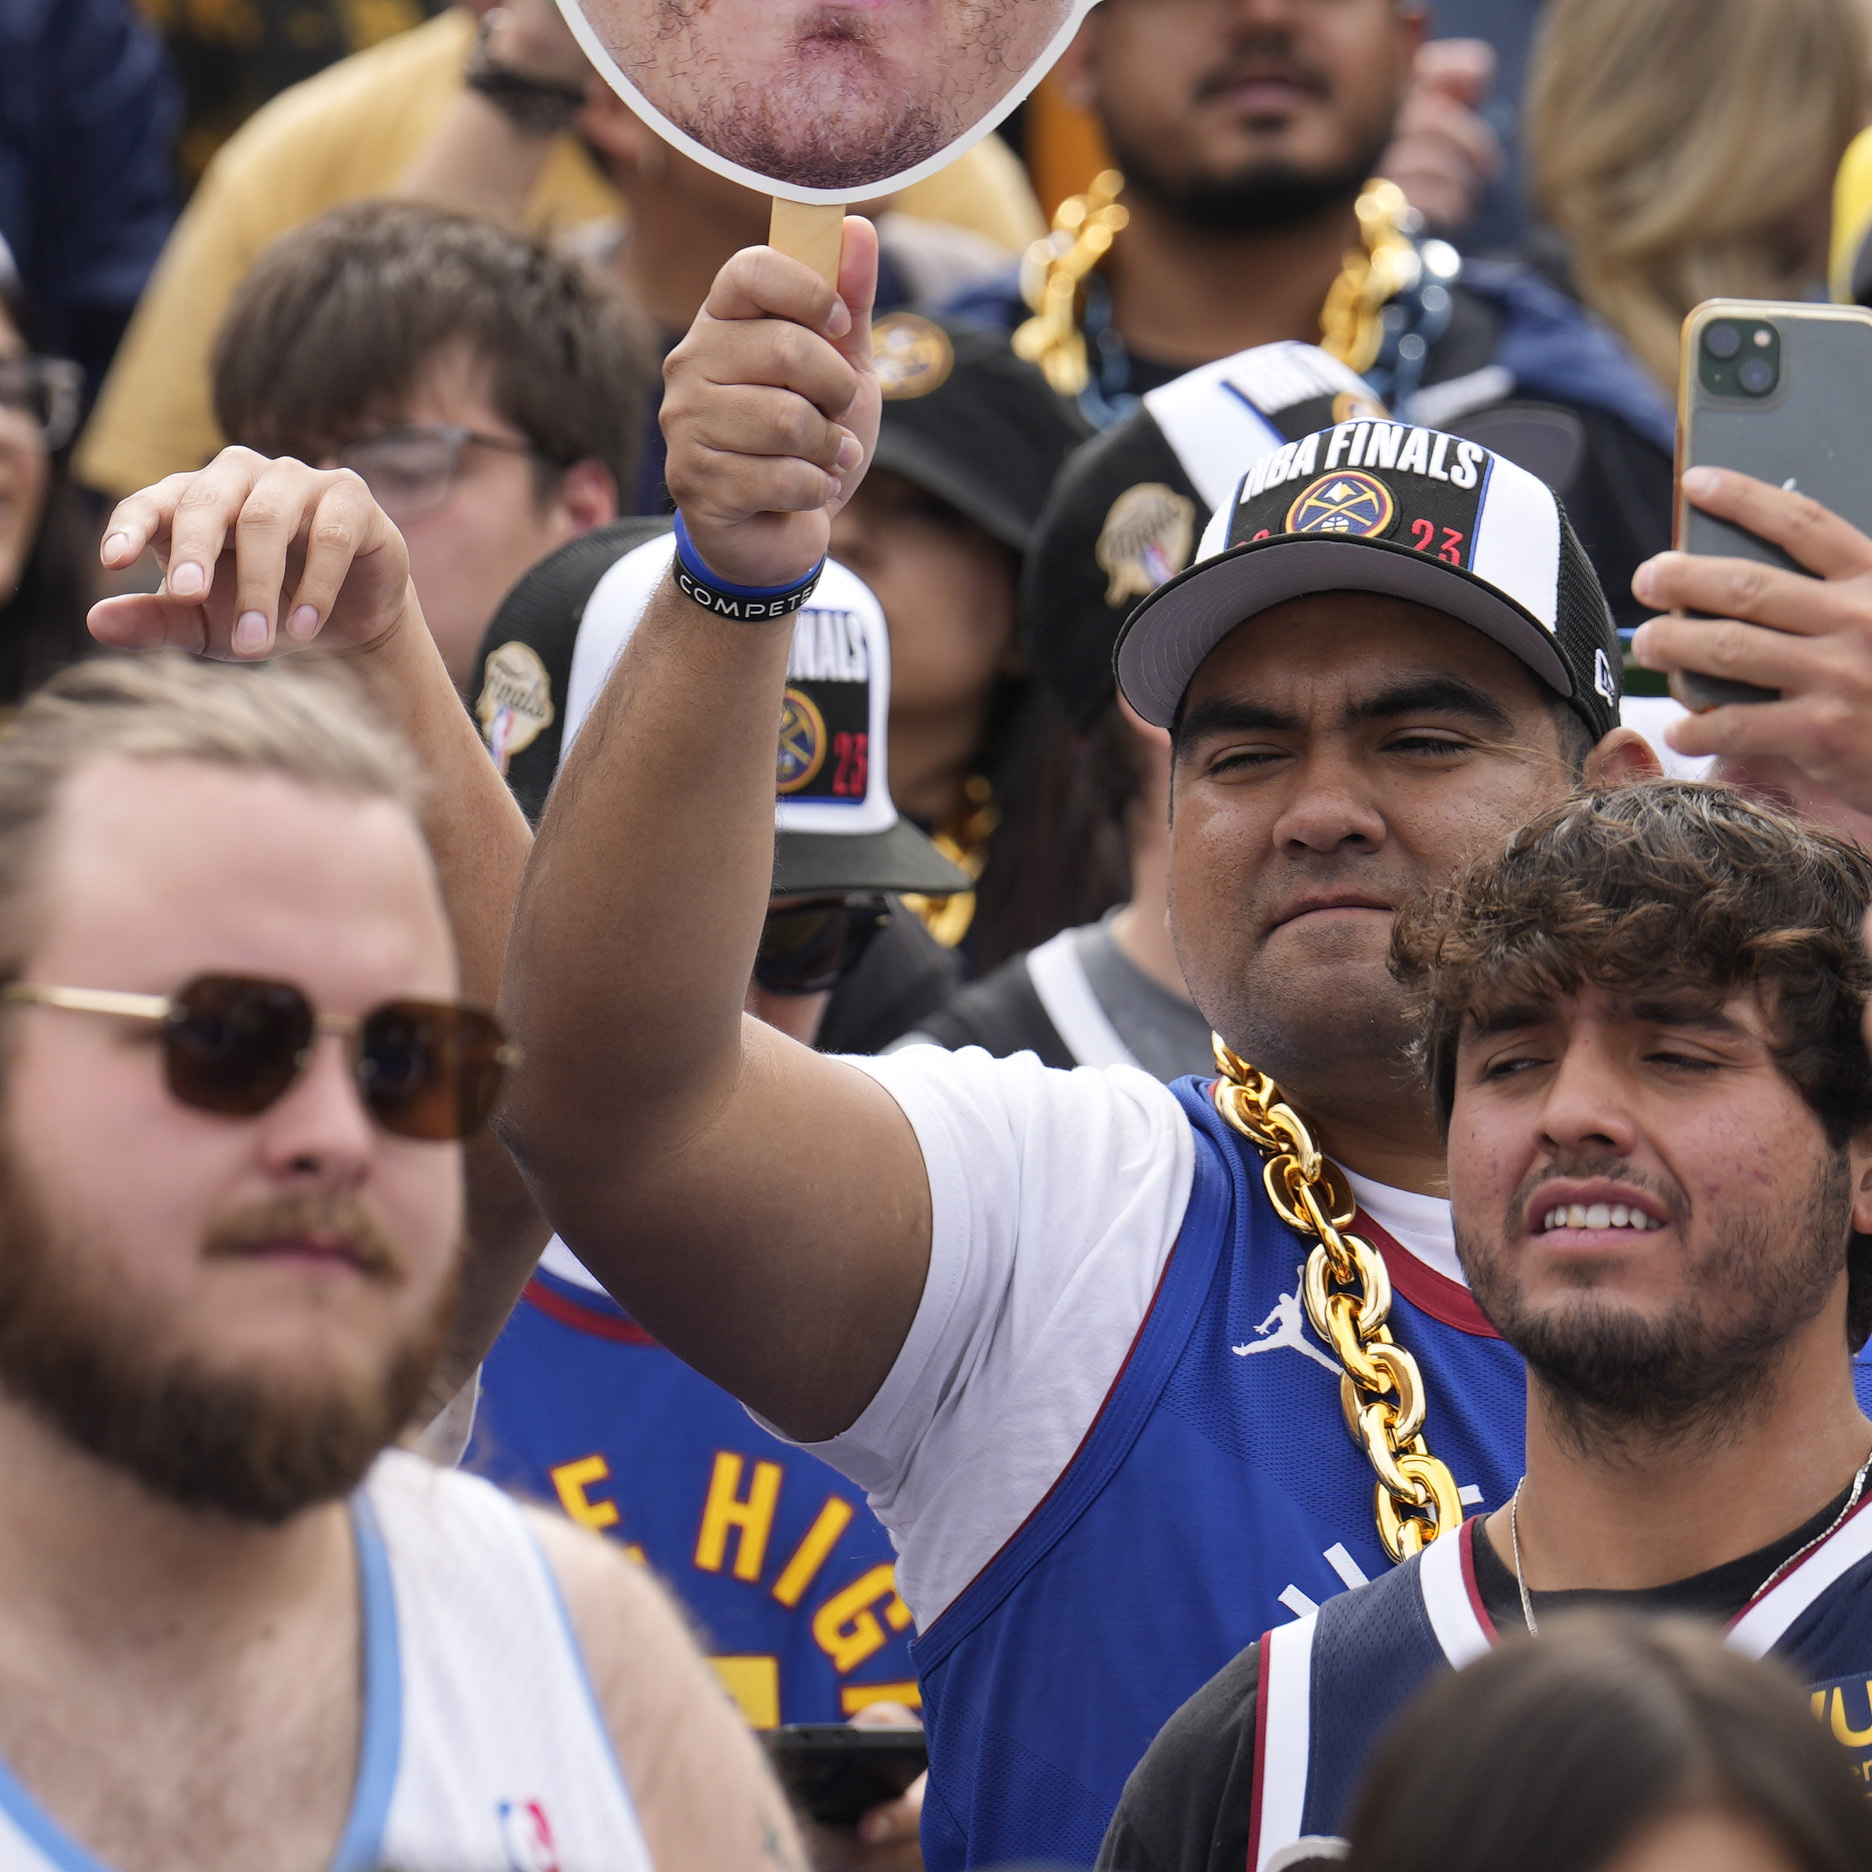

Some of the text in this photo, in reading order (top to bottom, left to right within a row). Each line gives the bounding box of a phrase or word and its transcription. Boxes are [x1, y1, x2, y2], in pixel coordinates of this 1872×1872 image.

[1239, 420, 1483, 506] NBA FINALS
[1410, 517, 1465, 567] 23
[787, 609, 869, 683] NALS
